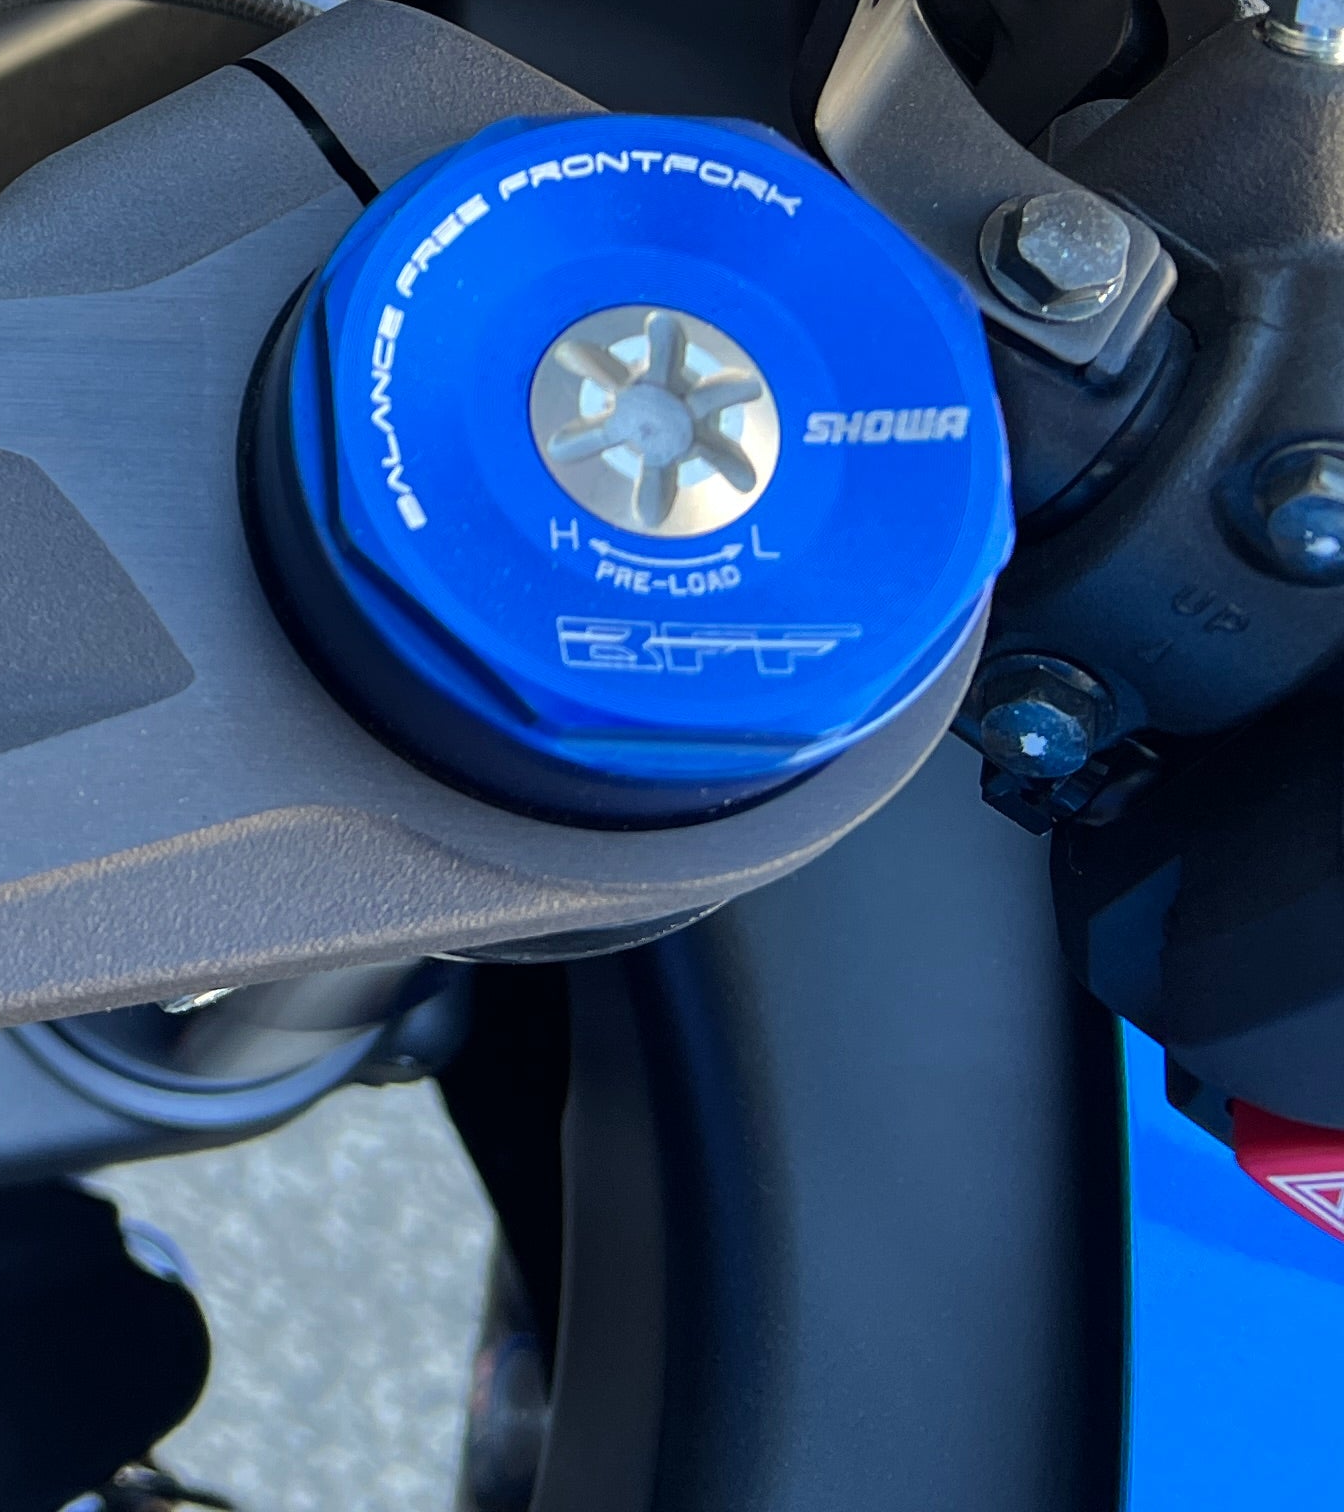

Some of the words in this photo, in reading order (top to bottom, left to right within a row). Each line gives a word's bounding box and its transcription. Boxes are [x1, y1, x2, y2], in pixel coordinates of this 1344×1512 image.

[498, 149, 803, 218] FRONTFORK
[396, 193, 490, 297] FREE
[369, 305, 428, 531] BALANCE
[802, 405, 970, 446] SHOWA
[549, 518, 581, 551] H
[751, 525, 781, 559] L
[596, 560, 742, 596] PRE-LOAD
